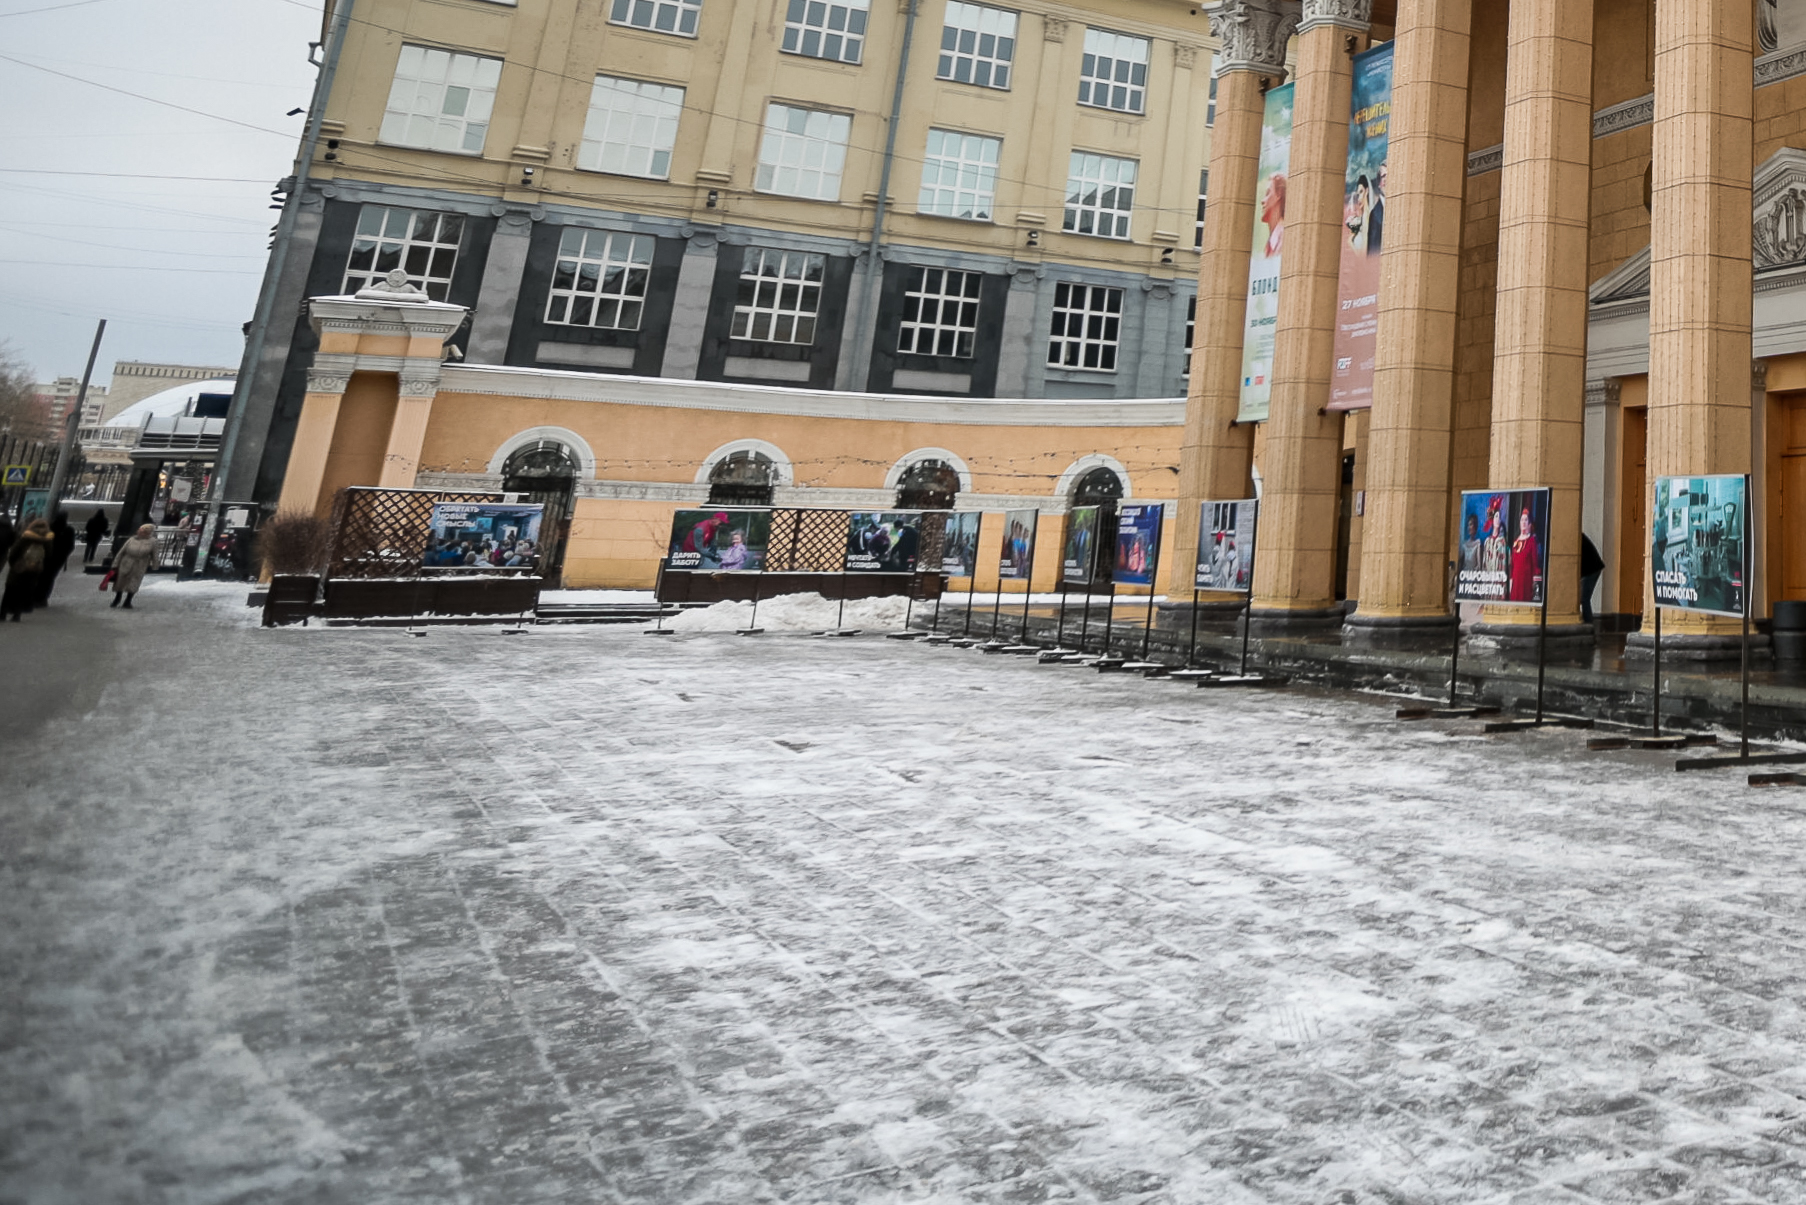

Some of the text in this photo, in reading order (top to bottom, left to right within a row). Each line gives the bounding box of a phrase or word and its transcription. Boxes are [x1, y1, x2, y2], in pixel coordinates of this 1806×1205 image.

[1342, 300, 1352, 310] 27
[1655, 570, 1687, 584] СПАСАТЬ
[1464, 583, 1505, 596] РАСЦВЕТАТЬ
[1656, 586, 1698, 601] И ПОМОГАТЬ
